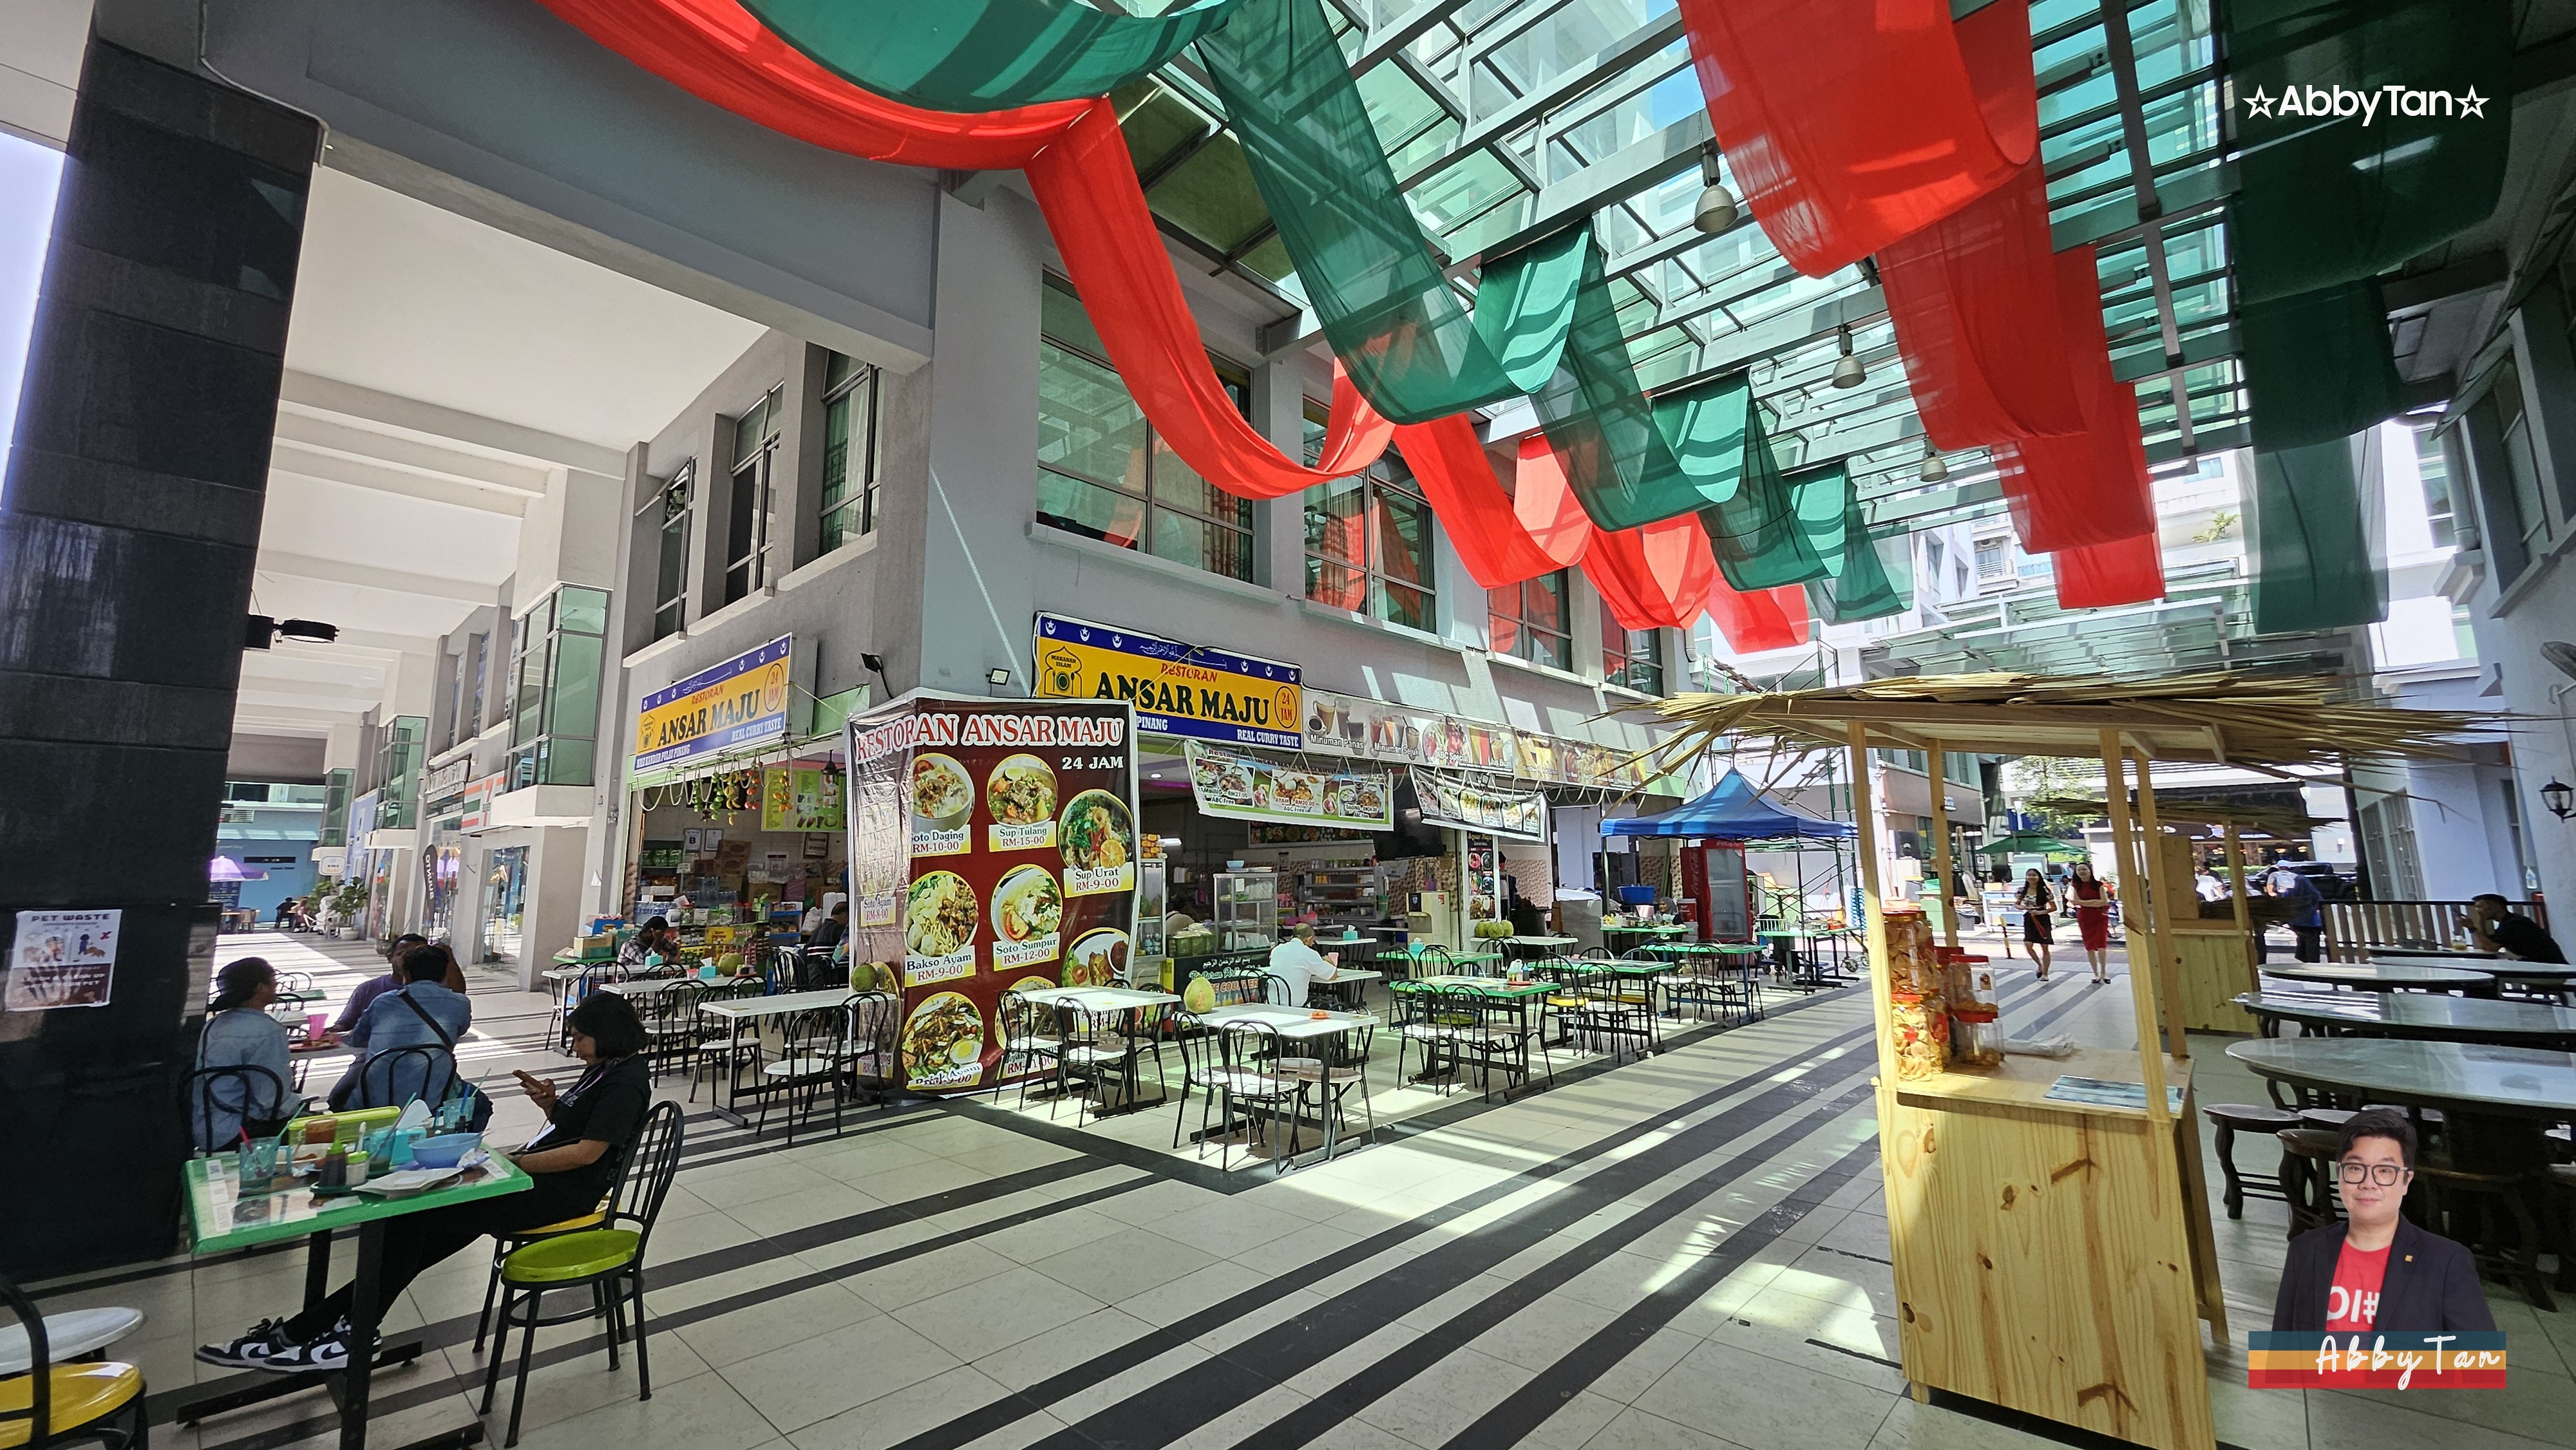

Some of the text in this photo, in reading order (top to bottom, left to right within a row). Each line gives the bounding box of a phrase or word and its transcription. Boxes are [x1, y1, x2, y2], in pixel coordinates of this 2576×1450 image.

[770, 670, 779, 684] 24
[1095, 671, 1269, 726] ANSAR MAJU
[1281, 692, 1291, 706] 24
[658, 688, 761, 748] ANSAR MAJU
[1280, 708, 1293, 722] JAM
[732, 717, 782, 742] REAL CURRY TASTE
[1137, 715, 1168, 731] PINANG
[856, 715, 1123, 761] RESTORAN ANSAR MAJU
[1237, 729, 1299, 748] REAL CURRY TASTE
[1310, 734, 1364, 750] Minuman Panas
[1208, 749, 1251, 761] Restaurant
[1374, 742, 1419, 757] Minuman Sejuk
[1436, 749, 1468, 762] ABC Special
[1062, 756, 1124, 769] 24 JAM
[1490, 757, 1499, 766] Jus
[932, 831, 964, 842] Daging
[999, 827, 1047, 838] Sup Tulang
[913, 841, 959, 853] RM-10-00
[1002, 836, 1045, 847] RM-15-00
[1075, 867, 1119, 880] Sup Urat
[1075, 878, 1119, 891] RM-9-00
[864, 897, 891, 909] Soto Ayam
[996, 938, 1057, 955] Soto Sumpur
[906, 954, 972, 971] Bakso Ayam
[1004, 948, 1050, 965] RM-12-00
[917, 965, 963, 981] RM-9-00
[1189, 970, 1224, 979] Rtoran
